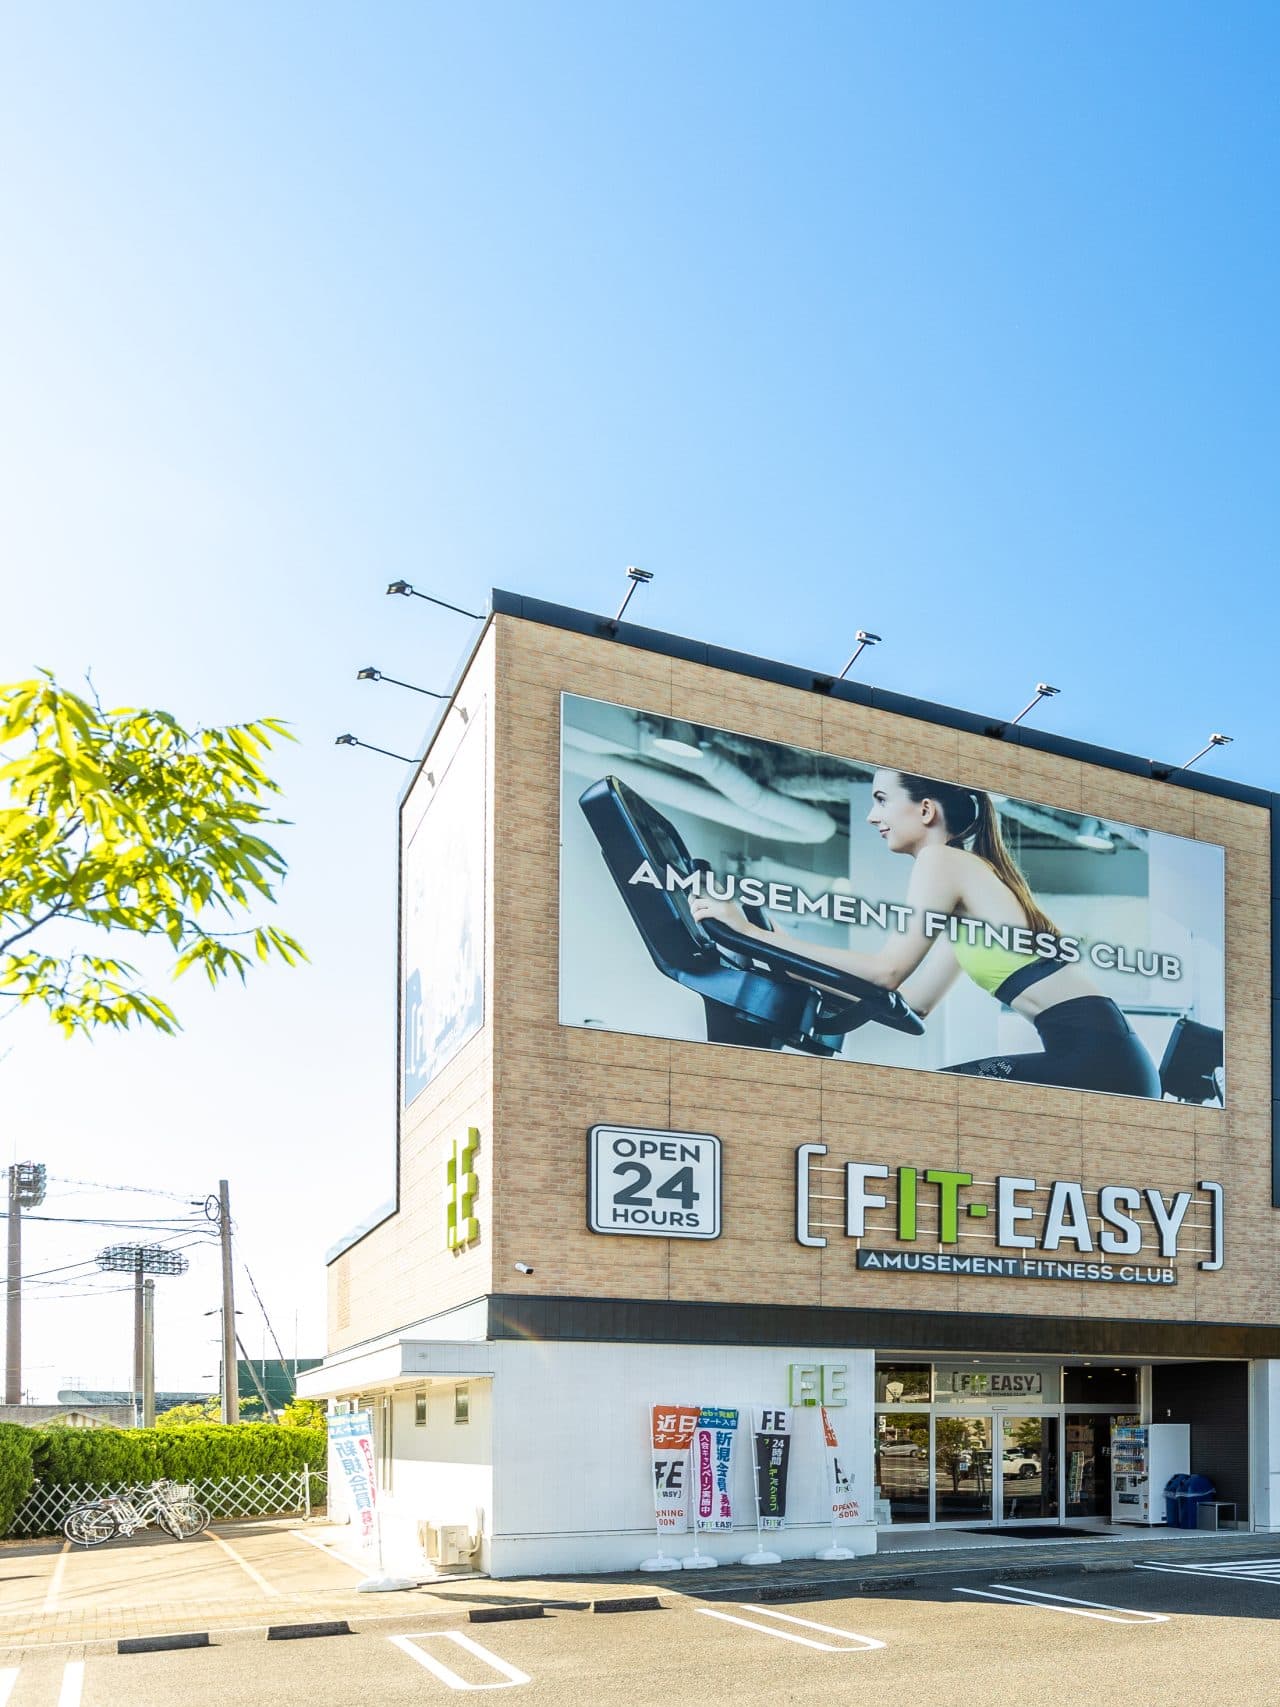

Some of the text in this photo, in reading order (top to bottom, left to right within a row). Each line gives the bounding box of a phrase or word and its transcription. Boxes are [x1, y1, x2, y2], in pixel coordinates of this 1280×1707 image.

[628, 860, 1182, 980] AMUSEMENT FITNESS CLUB
[612, 1138, 701, 1162] OPEN
[612, 1162, 701, 1209] 24
[611, 1208, 701, 1229] HOURS
[863, 1252, 1175, 1284] AMUSEMENT FITNESS CLUB
[657, 1414, 697, 1433] 近日
